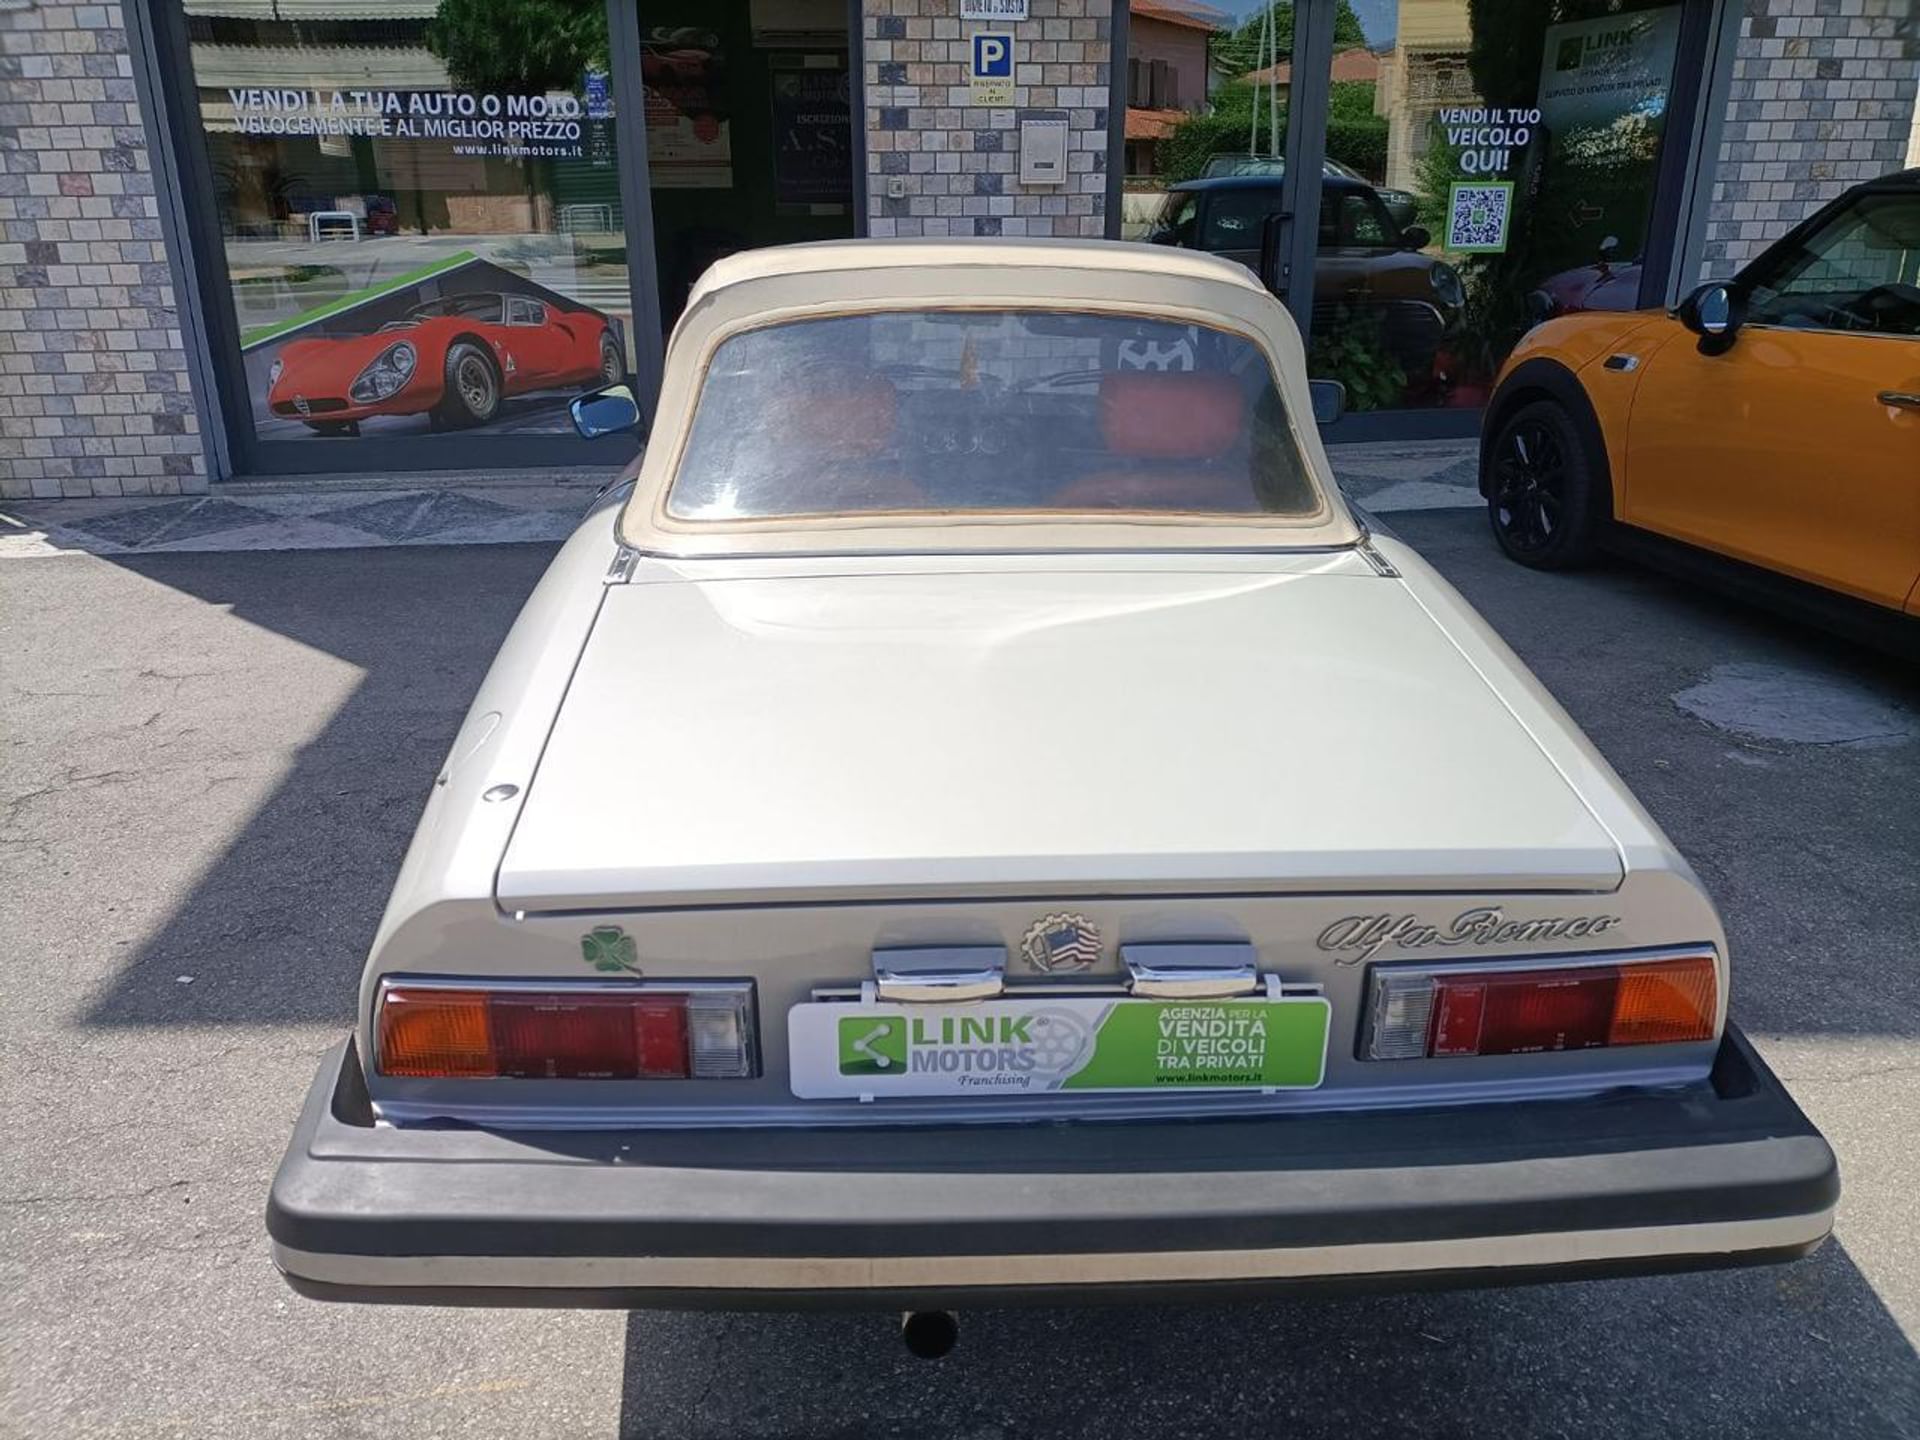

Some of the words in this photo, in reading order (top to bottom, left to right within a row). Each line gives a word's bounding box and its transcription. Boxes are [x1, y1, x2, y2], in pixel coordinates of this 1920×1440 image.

[981, 40, 1004, 73] P
[228, 89, 308, 111] VENDI
[315, 90, 347, 113] LA
[350, 91, 402, 114] TUA
[409, 93, 476, 115] AUTO
[482, 94, 499, 116] O
[507, 95, 580, 117] MOTO
[1440, 109, 1488, 123] VENDI
[1491, 109, 1505, 123] IL
[1508, 109, 1541, 124] TUO
[235, 116, 379, 136] VELOCEMENTE
[381, 118, 391, 136] E
[396, 119, 420, 137] AL
[424, 119, 504, 138] MIGLIOR
[508, 121, 581, 140] PREZZO
[1448, 127, 1530, 146] VEICOLO
[453, 143, 583, 157] www.linkmotors.it
[1460, 149, 1510, 173] QUI!
[1316, 913, 1438, 968] Alfa
[1440, 905, 1622, 946] Romeo
[1159, 1008, 1226, 1020] AGENZIA
[1229, 1009, 1250, 1019] PER
[1252, 1009, 1268, 1019] LA
[912, 1016, 1034, 1045] LINK
[1159, 1020, 1267, 1038] VENDITA
[1158, 1039, 1177, 1054] DI
[1183, 1038, 1266, 1054] VEICOLI
[912, 1048, 1036, 1072] MOTORS
[1156, 1055, 1190, 1069] TRA
[1196, 1055, 1264, 1069] PRIVATI
[958, 1072, 1031, 1088] Franchising
[1156, 1072, 1263, 1083] www.linkmotors.it
